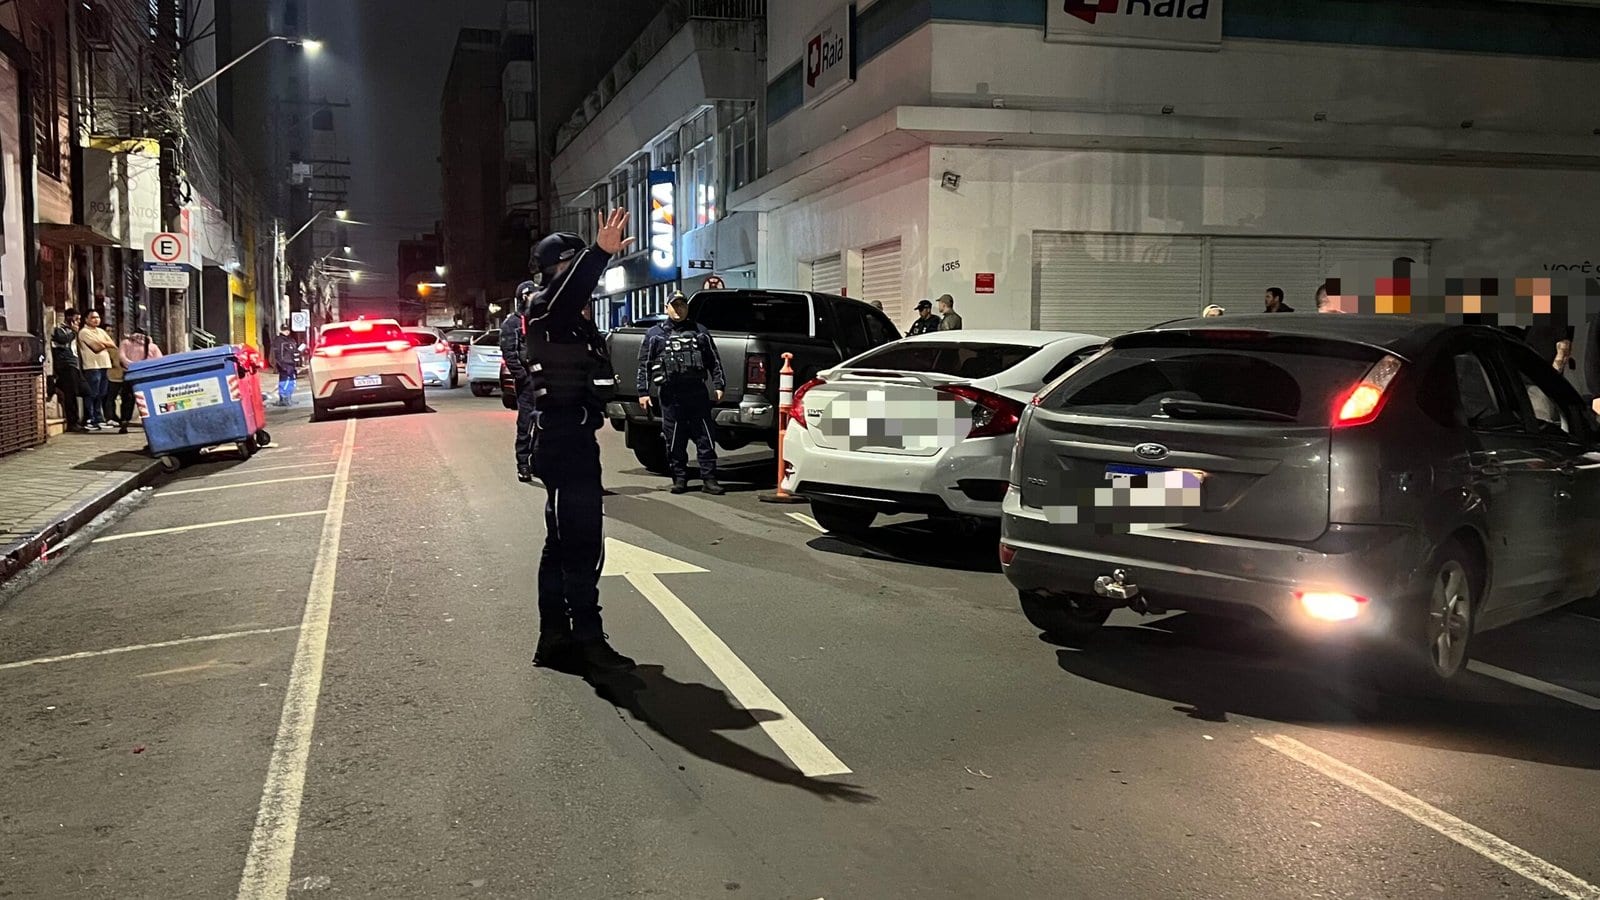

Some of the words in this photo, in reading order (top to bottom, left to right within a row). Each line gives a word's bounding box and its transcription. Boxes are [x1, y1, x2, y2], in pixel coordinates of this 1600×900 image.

[822, 32, 843, 73] Raia
[652, 182, 674, 268] CAIXA
[161, 240, 173, 256] E
[942, 260, 960, 272] 1365
